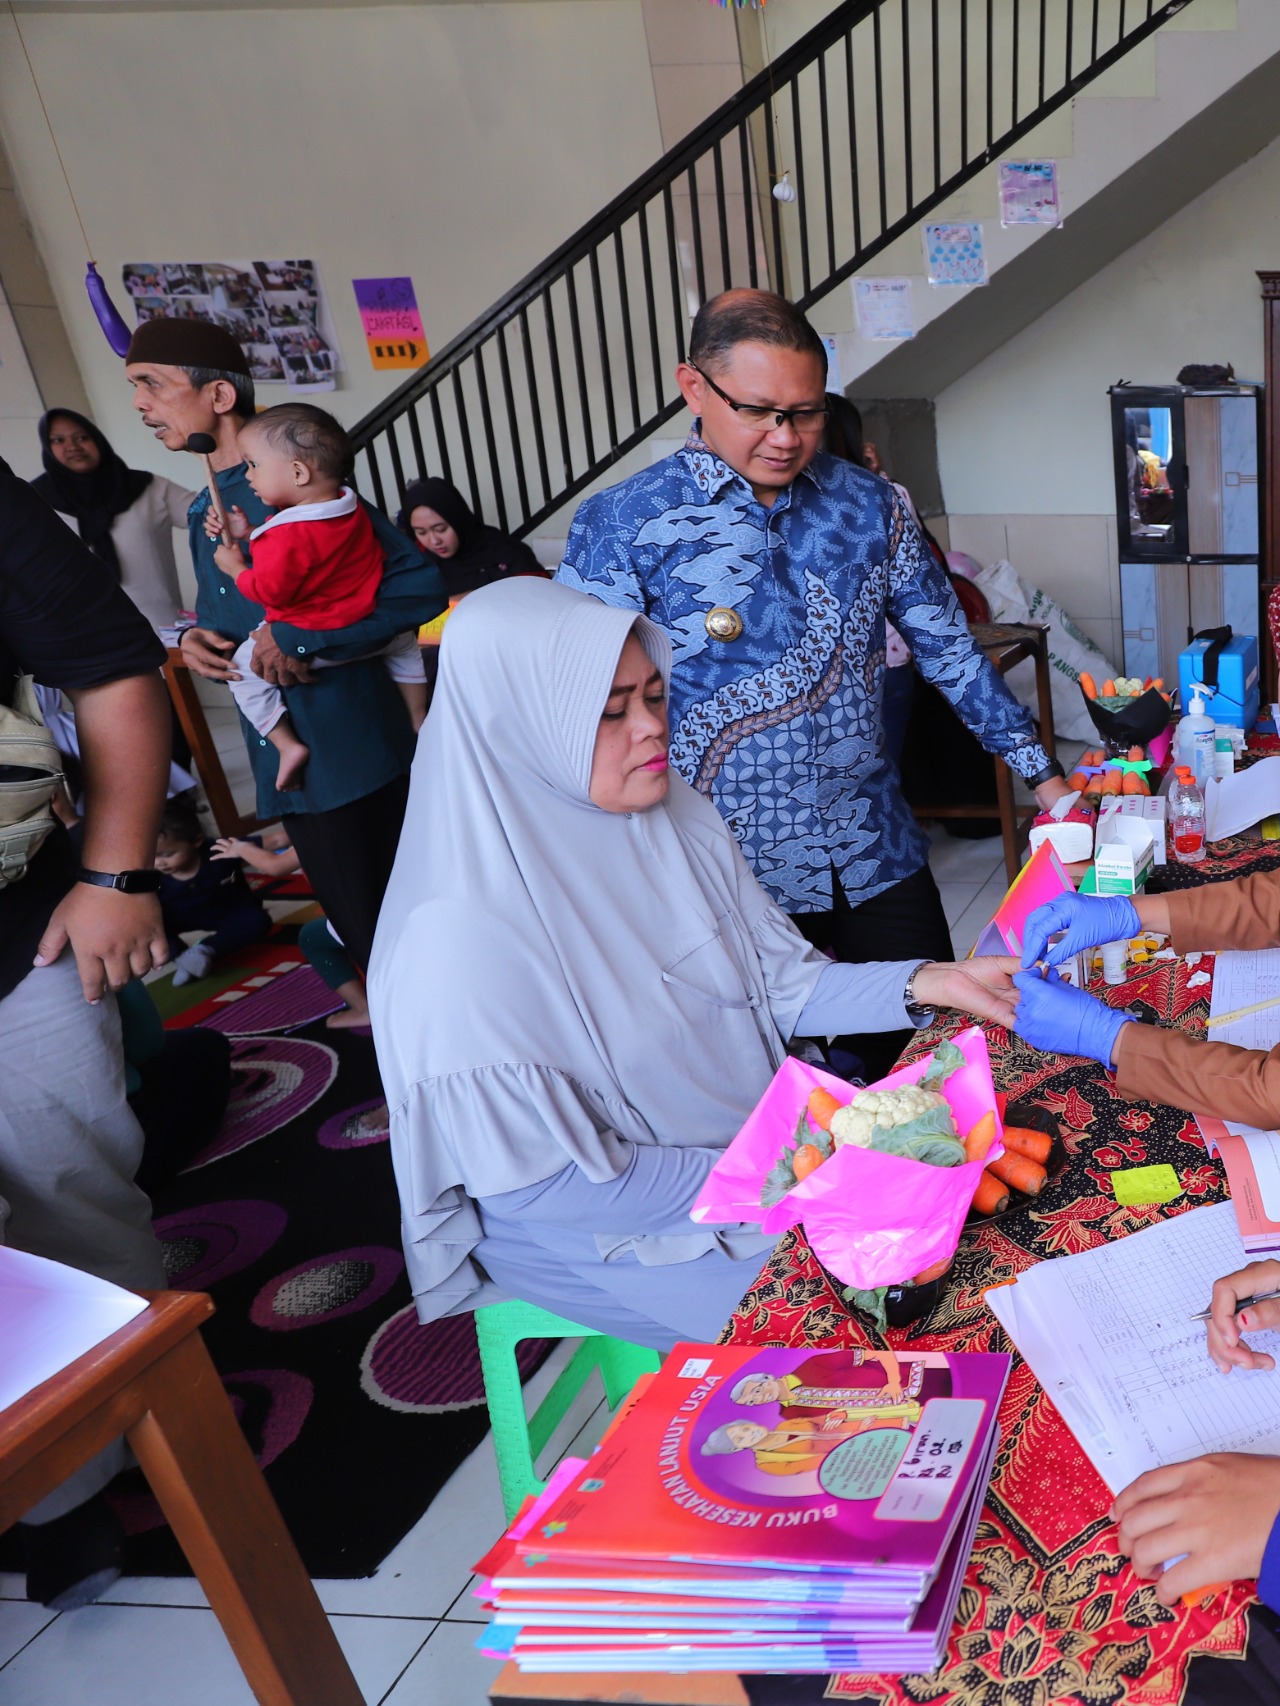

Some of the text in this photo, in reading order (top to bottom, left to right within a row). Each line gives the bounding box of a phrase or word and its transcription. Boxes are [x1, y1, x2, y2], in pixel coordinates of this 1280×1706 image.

[679, 1375, 723, 1412] USIA
[658, 1416, 689, 1476] LANJUT
[662, 1474, 762, 1528] KESEHATAN
[765, 1504, 838, 1528] BUKU
